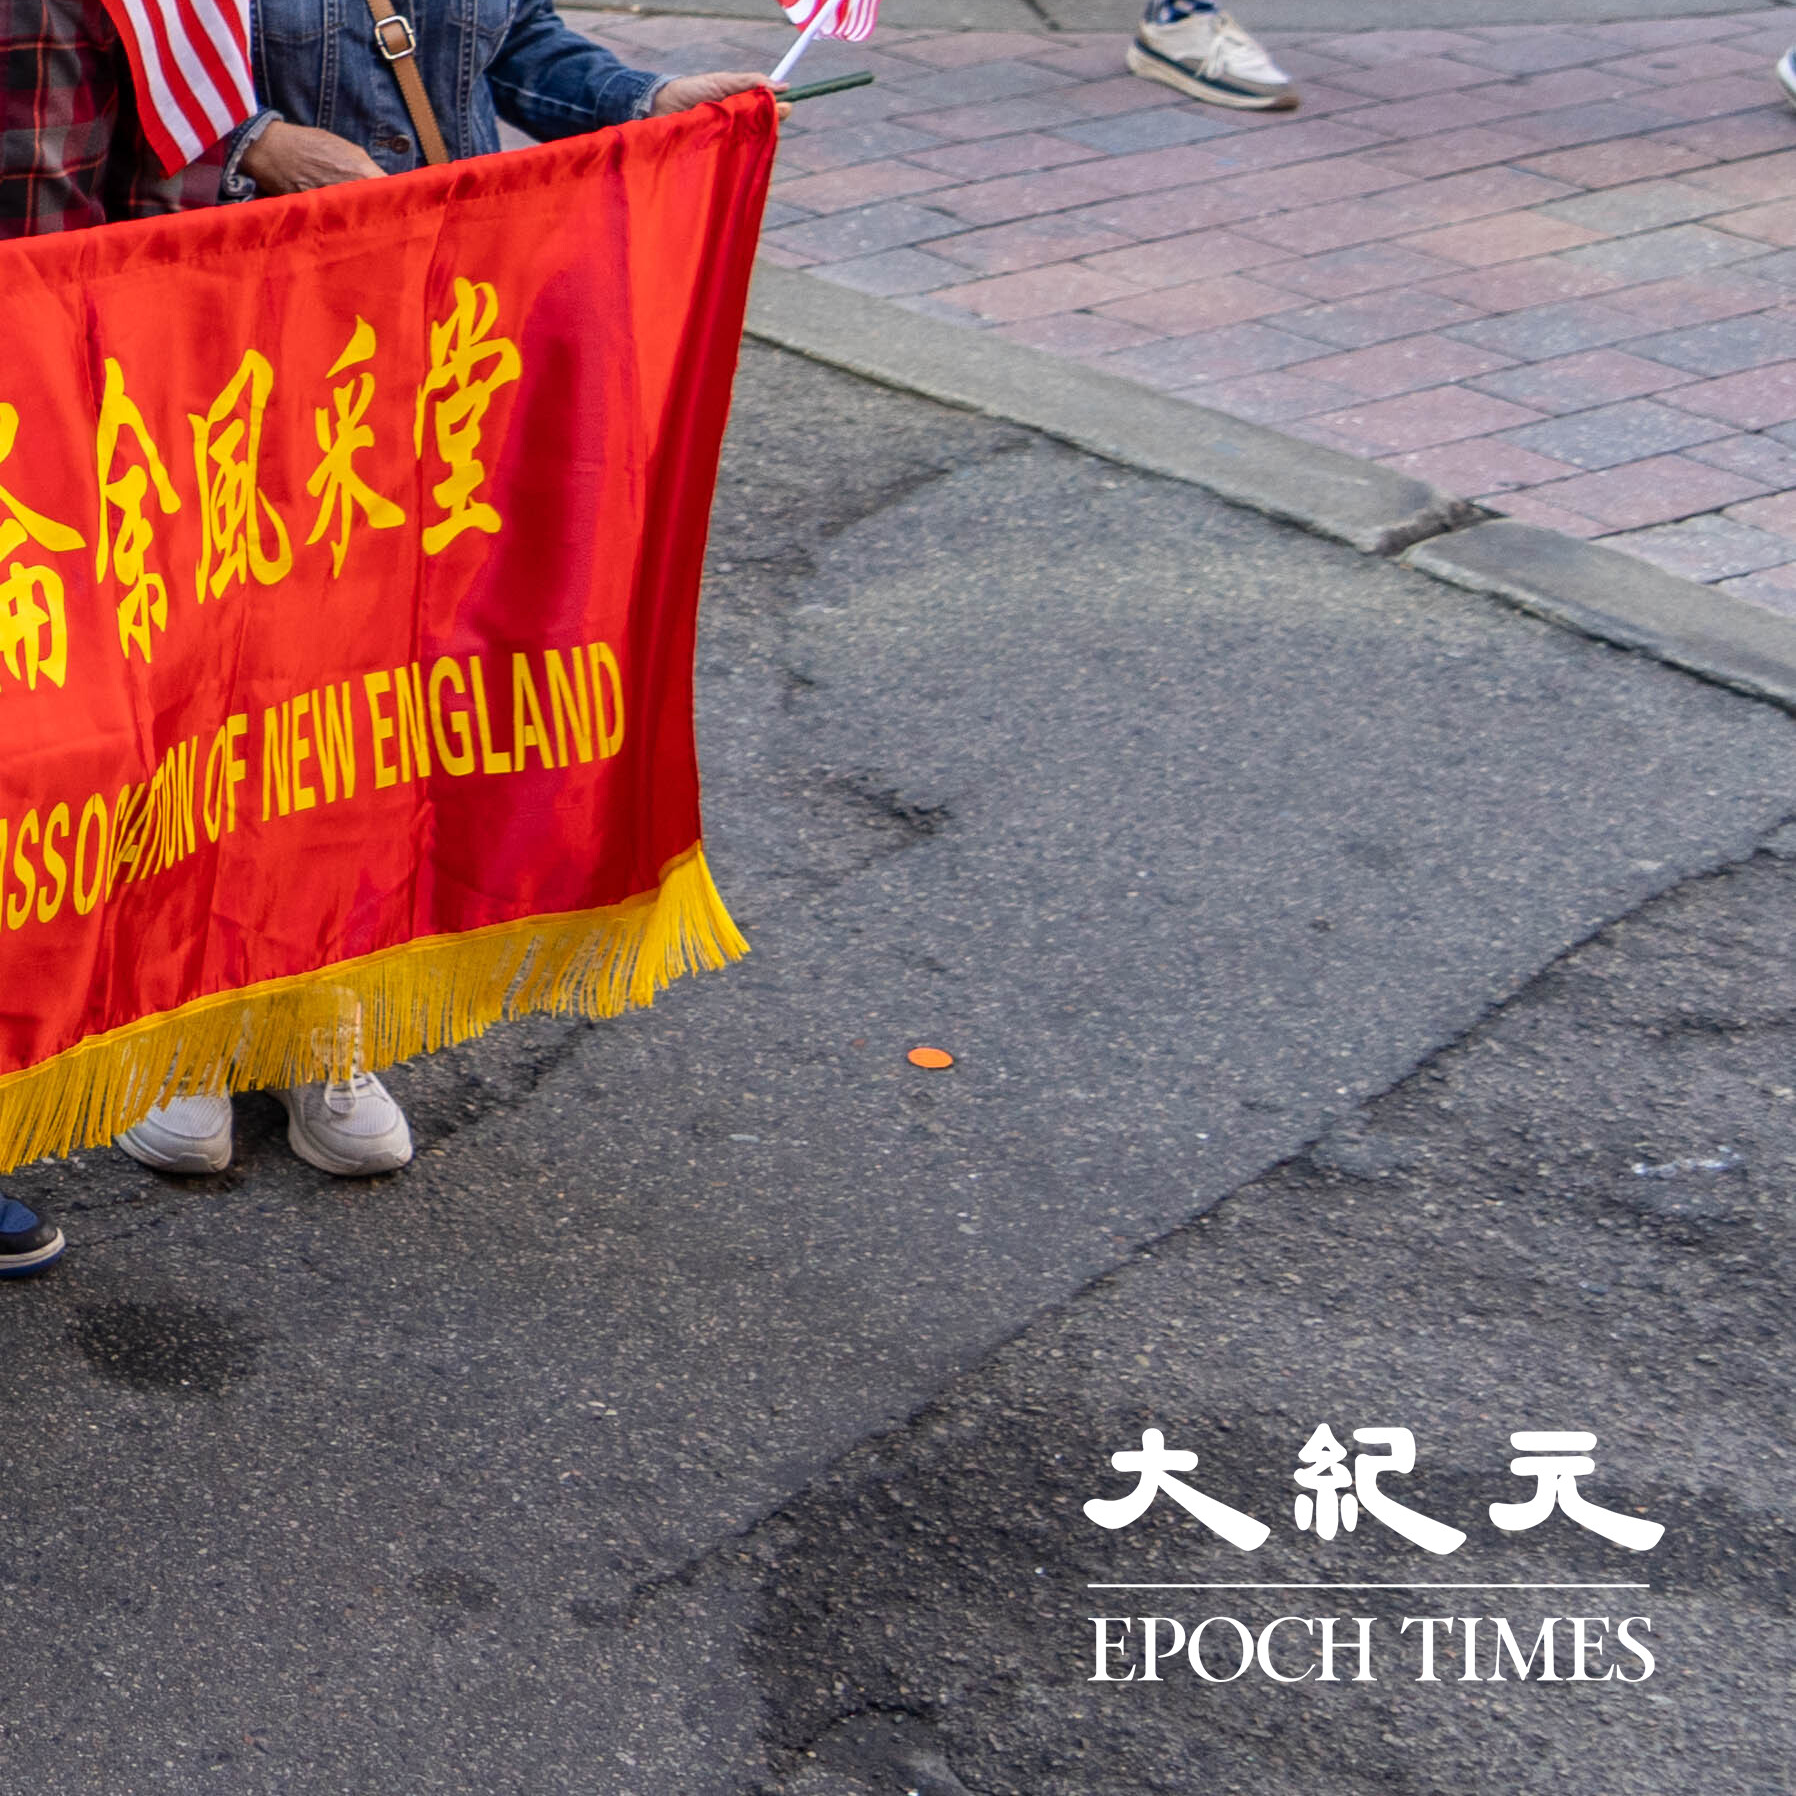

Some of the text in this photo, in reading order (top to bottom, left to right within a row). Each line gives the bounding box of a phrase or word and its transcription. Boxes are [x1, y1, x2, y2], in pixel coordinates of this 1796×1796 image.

[203, 714, 247, 842] OF
[263, 681, 355, 821] NEW
[370, 642, 624, 789] ENGLAND
